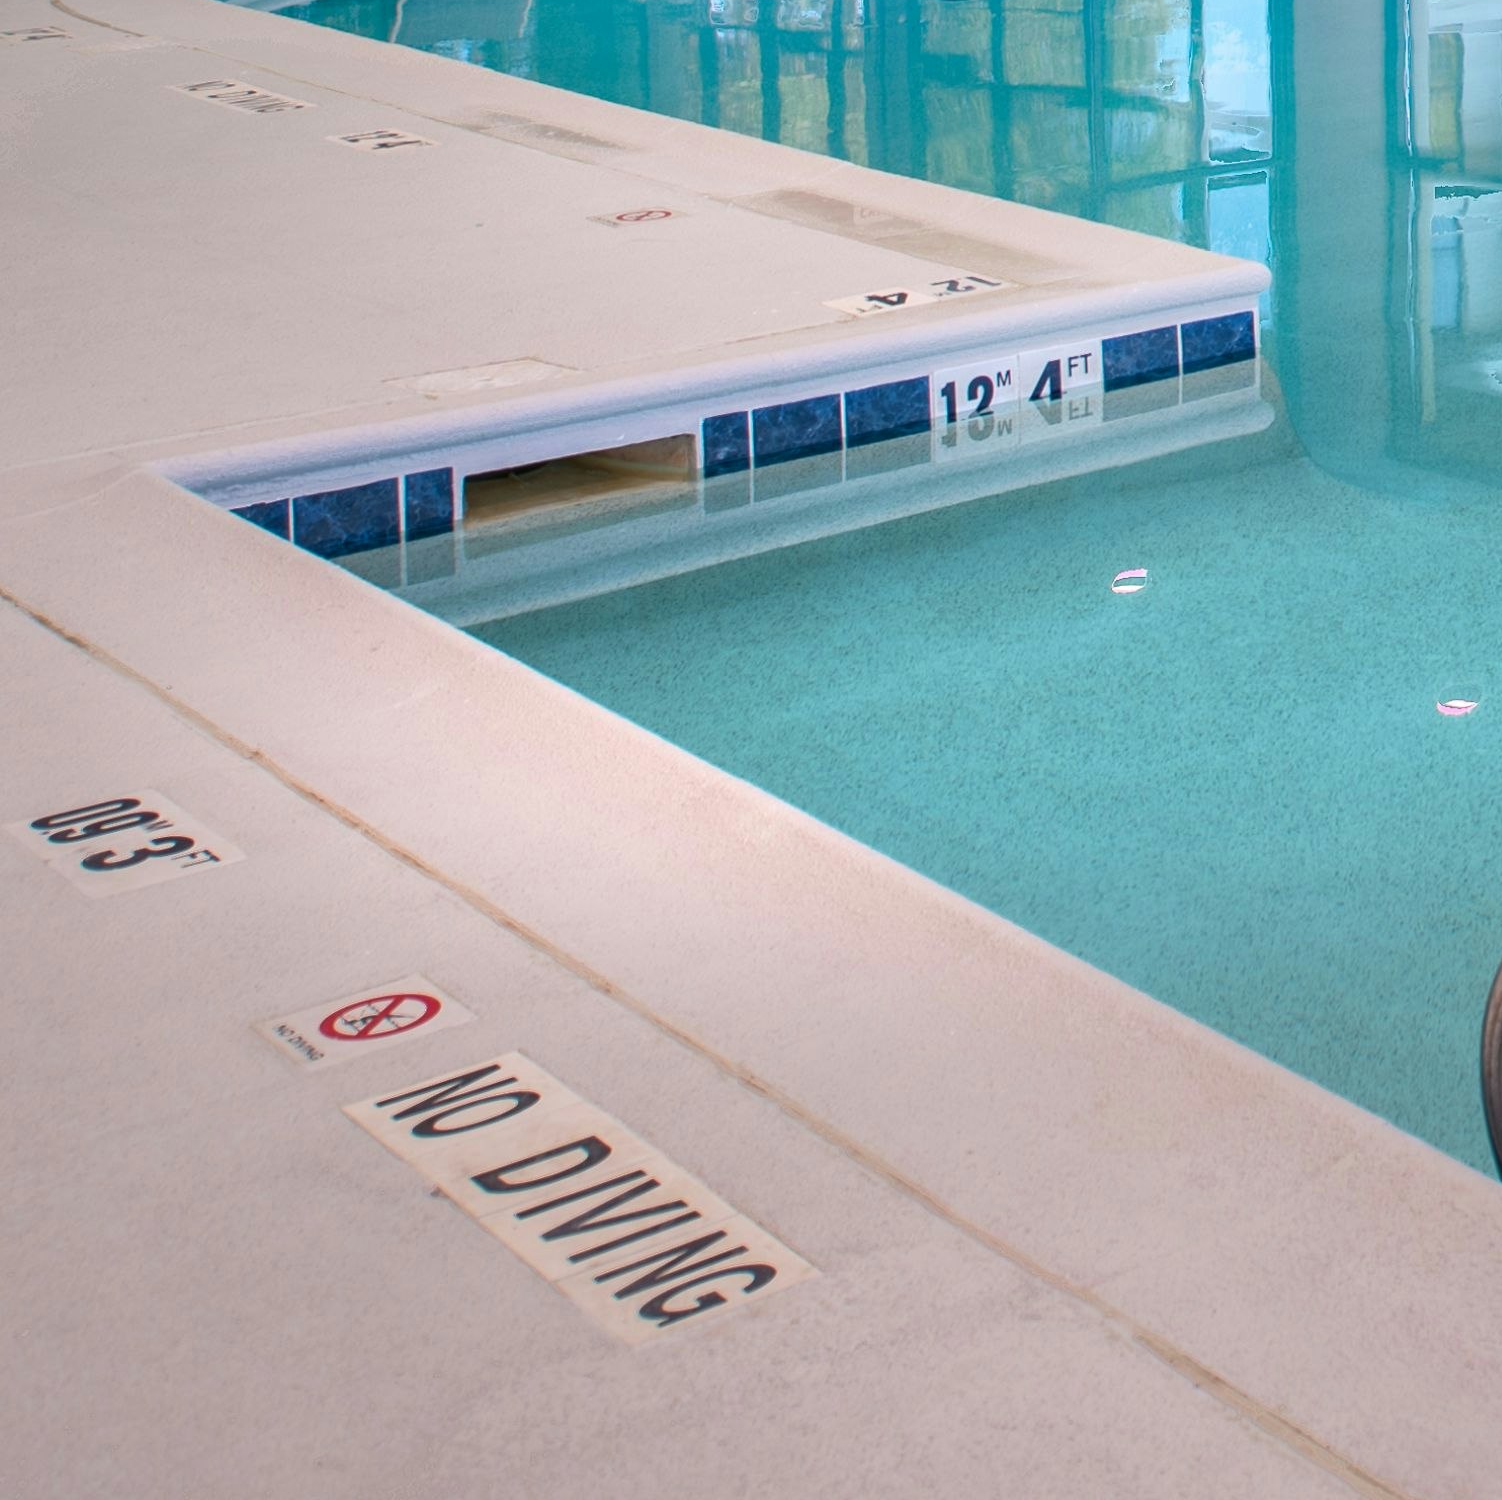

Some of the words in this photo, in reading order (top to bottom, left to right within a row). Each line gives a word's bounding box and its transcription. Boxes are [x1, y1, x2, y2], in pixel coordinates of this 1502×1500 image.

[276, 1024, 295, 1037] NO
[287, 1035, 325, 1061] DIVING
[375, 1063, 541, 1139] NO
[470, 1135, 778, 1328] DIVING
